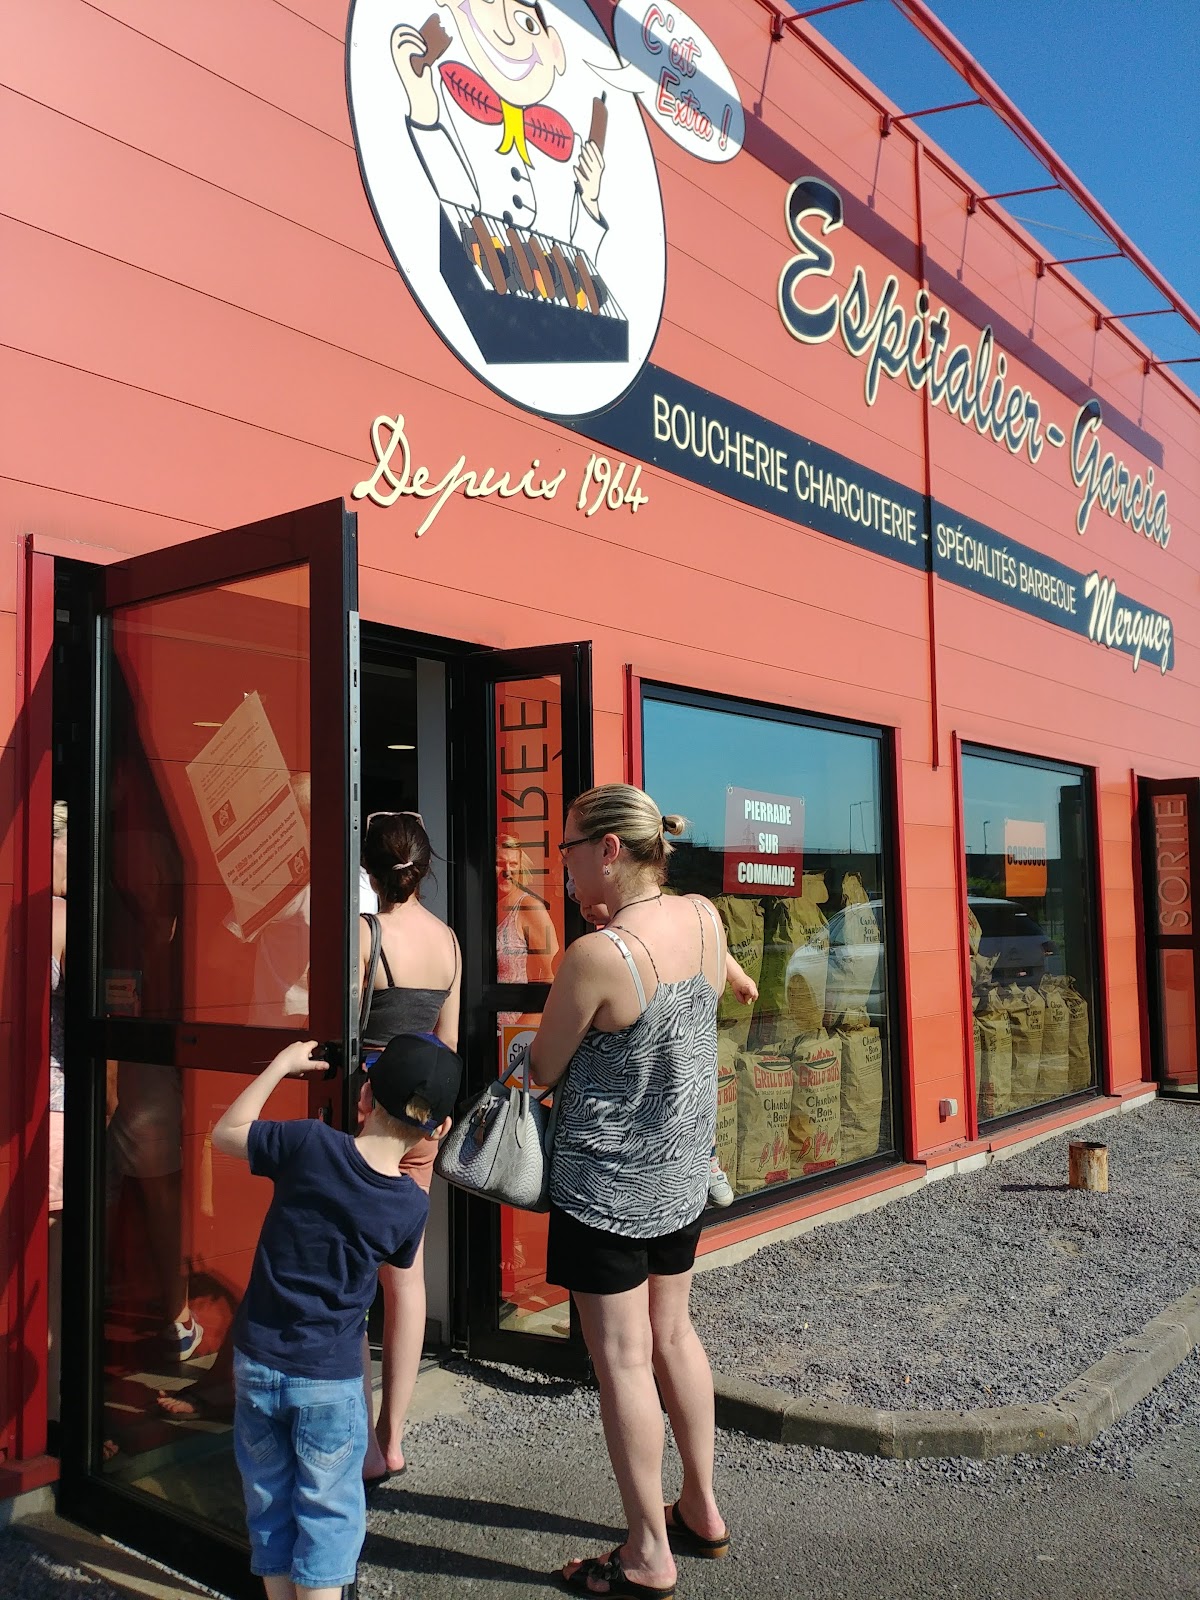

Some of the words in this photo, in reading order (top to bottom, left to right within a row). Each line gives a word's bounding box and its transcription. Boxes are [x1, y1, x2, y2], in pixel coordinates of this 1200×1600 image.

[642, 4, 701, 77] C'est
[656, 66, 714, 141] Extra
[350, 414, 567, 538] Depuis
[576, 454, 649, 517] 1964
[653, 394, 789, 493] BOUCHERIE
[795, 460, 917, 546] CHARCUTERIE
[936, 523, 1017, 588] SPÉCIALITÉS
[1020, 562, 1077, 615] BARBECUE
[1085, 570, 1171, 676] Merguez
[744, 798, 792, 825] PIERRADE
[758, 832, 779, 855] SUR
[737, 862, 795, 887] COMMANDE
[1007, 846, 1046, 867] COUSCOUS
[1155, 800, 1190, 927] SORTIE
